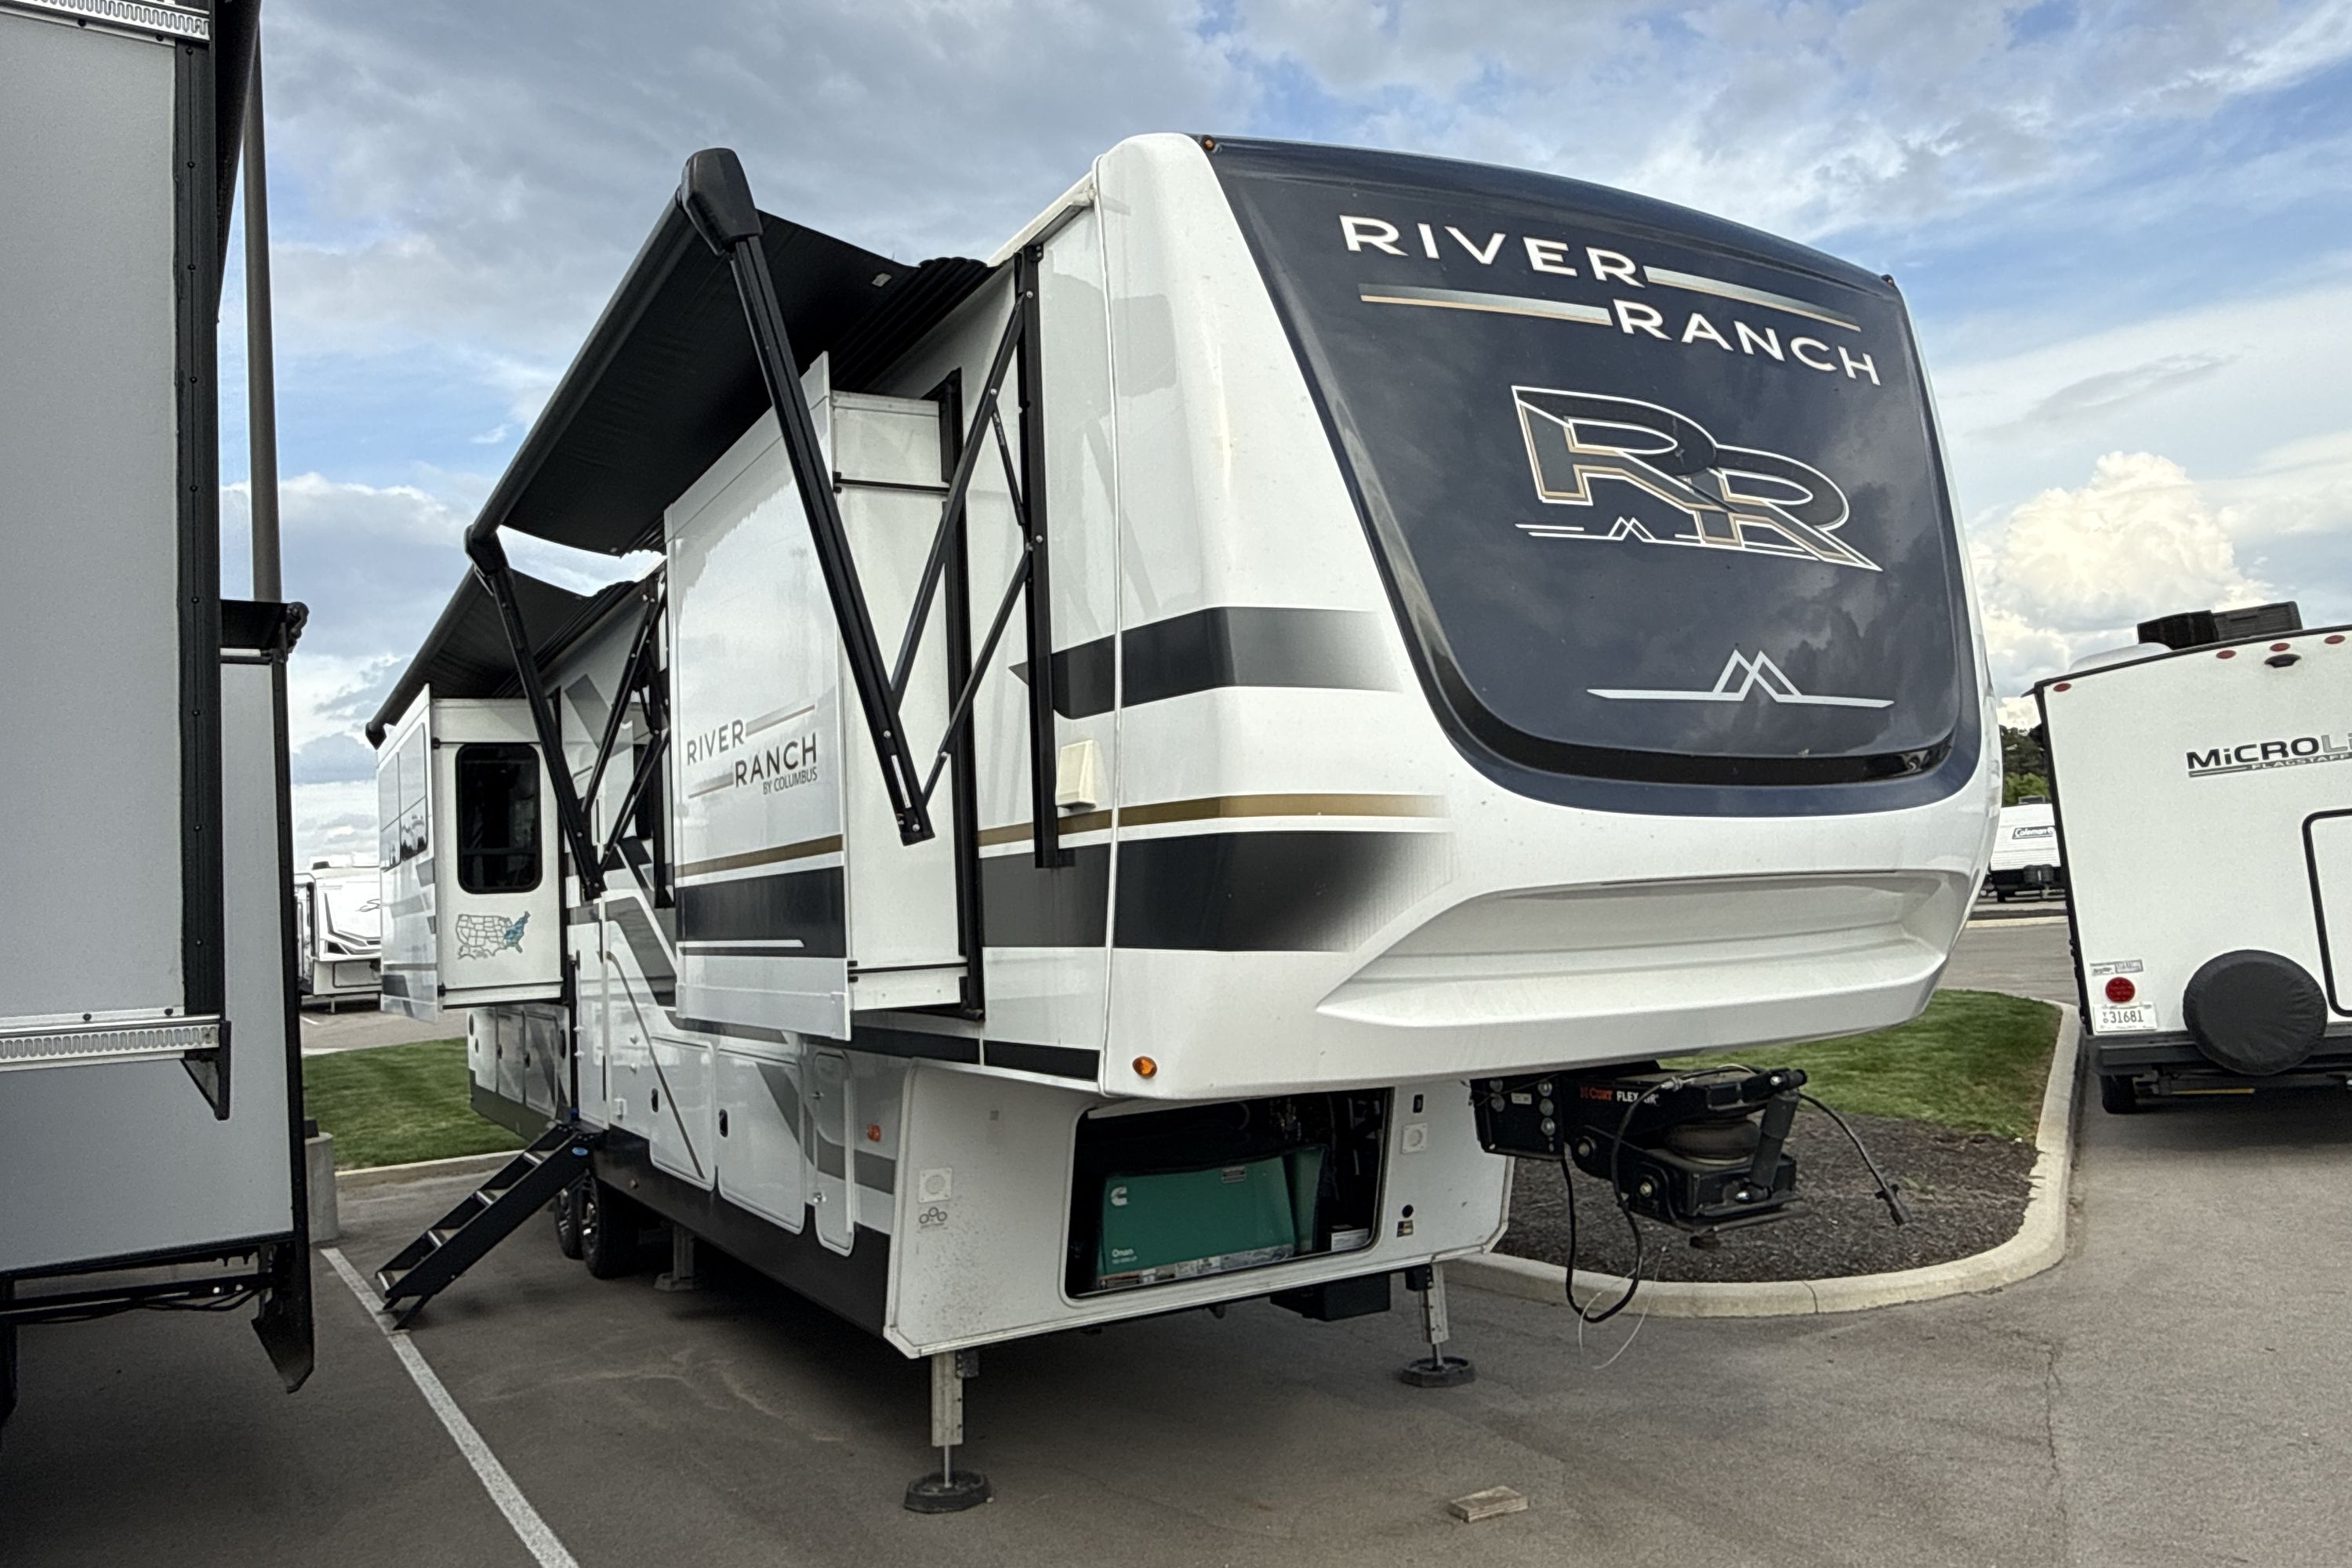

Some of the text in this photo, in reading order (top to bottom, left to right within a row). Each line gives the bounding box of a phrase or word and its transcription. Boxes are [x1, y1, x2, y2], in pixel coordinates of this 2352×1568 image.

[1339, 215, 1646, 289] RIVER
[1612, 299, 1881, 386] RANCH
[687, 720, 744, 764] RIVER
[735, 733, 817, 787] RANCH
[2252, 752, 2350, 771] FLAGSTAFF
[763, 768, 817, 795] BY COLUMBUS
[2014, 828, 2047, 837] Coleman
[2109, 1010, 2143, 1023] 31681
[1617, 1091, 1639, 1102] FLEX
